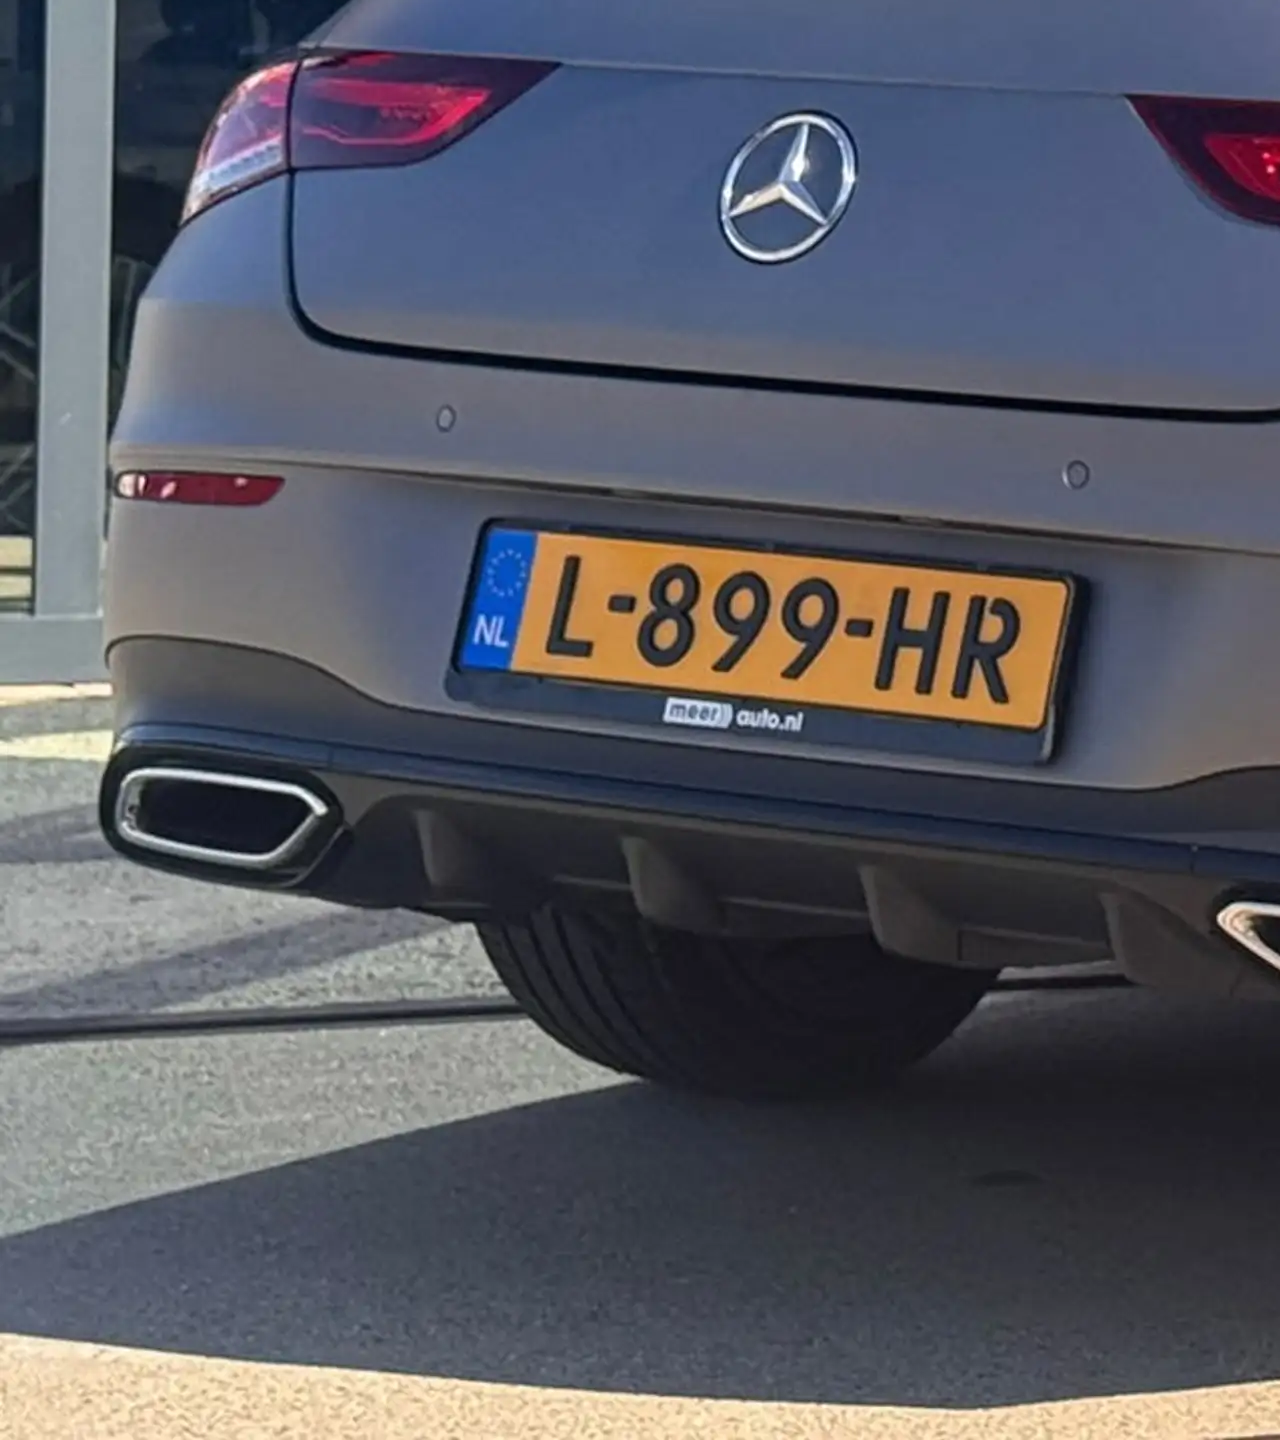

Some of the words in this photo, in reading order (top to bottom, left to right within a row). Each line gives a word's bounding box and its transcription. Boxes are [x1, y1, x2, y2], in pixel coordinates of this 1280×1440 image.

[473, 613, 509, 648] NL
[545, 555, 1021, 704] L-899-HR
[669, 702, 719, 722] meer
[736, 708, 804, 732] auto.nl
